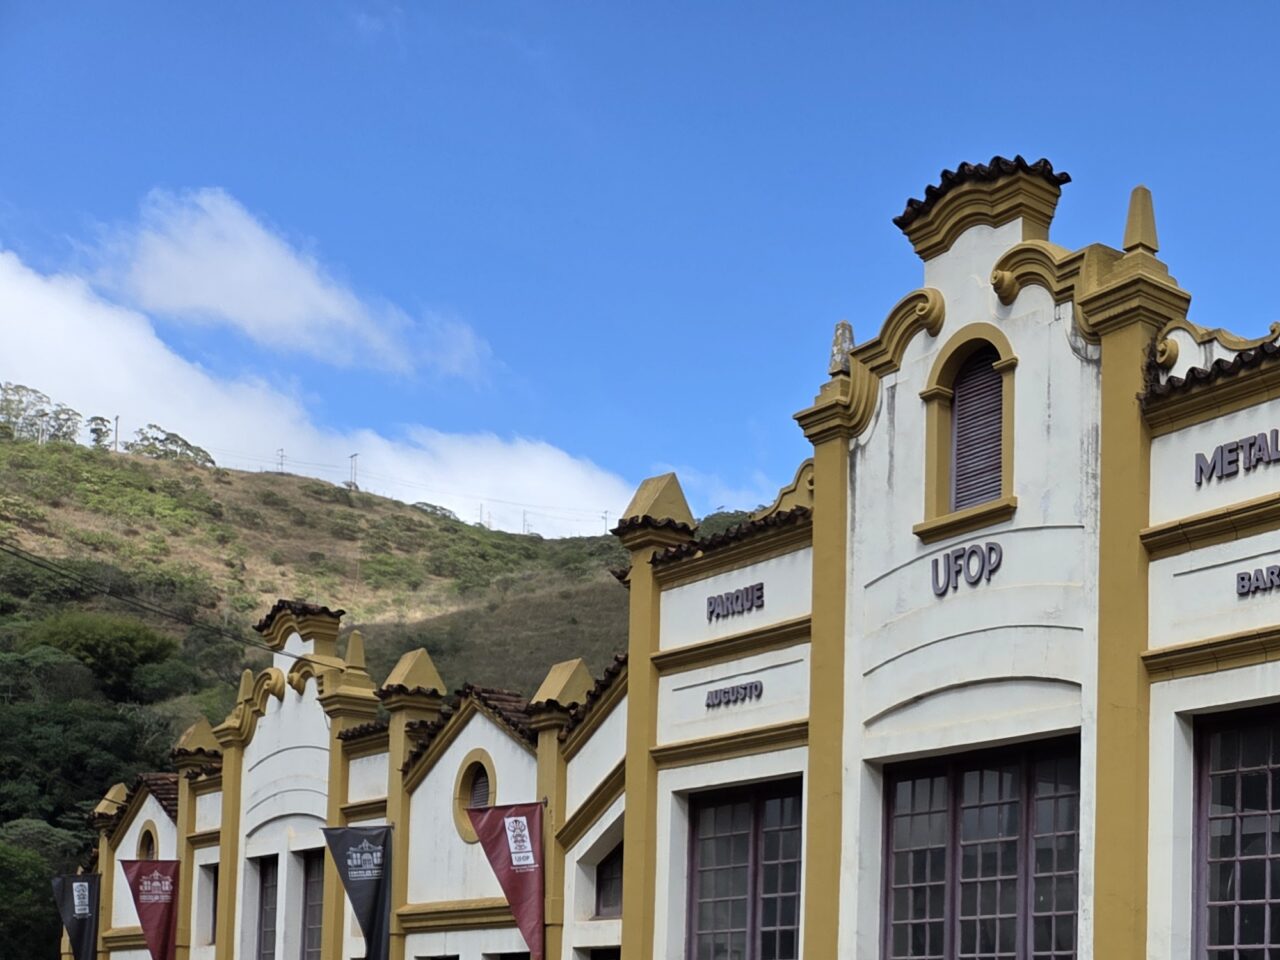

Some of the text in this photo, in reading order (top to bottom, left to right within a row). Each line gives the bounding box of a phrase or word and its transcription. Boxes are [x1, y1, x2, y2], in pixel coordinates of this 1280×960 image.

[931, 542, 1003, 597] UFOP
[707, 582, 764, 622] PARQUE
[705, 680, 763, 708] AUGUSTO
